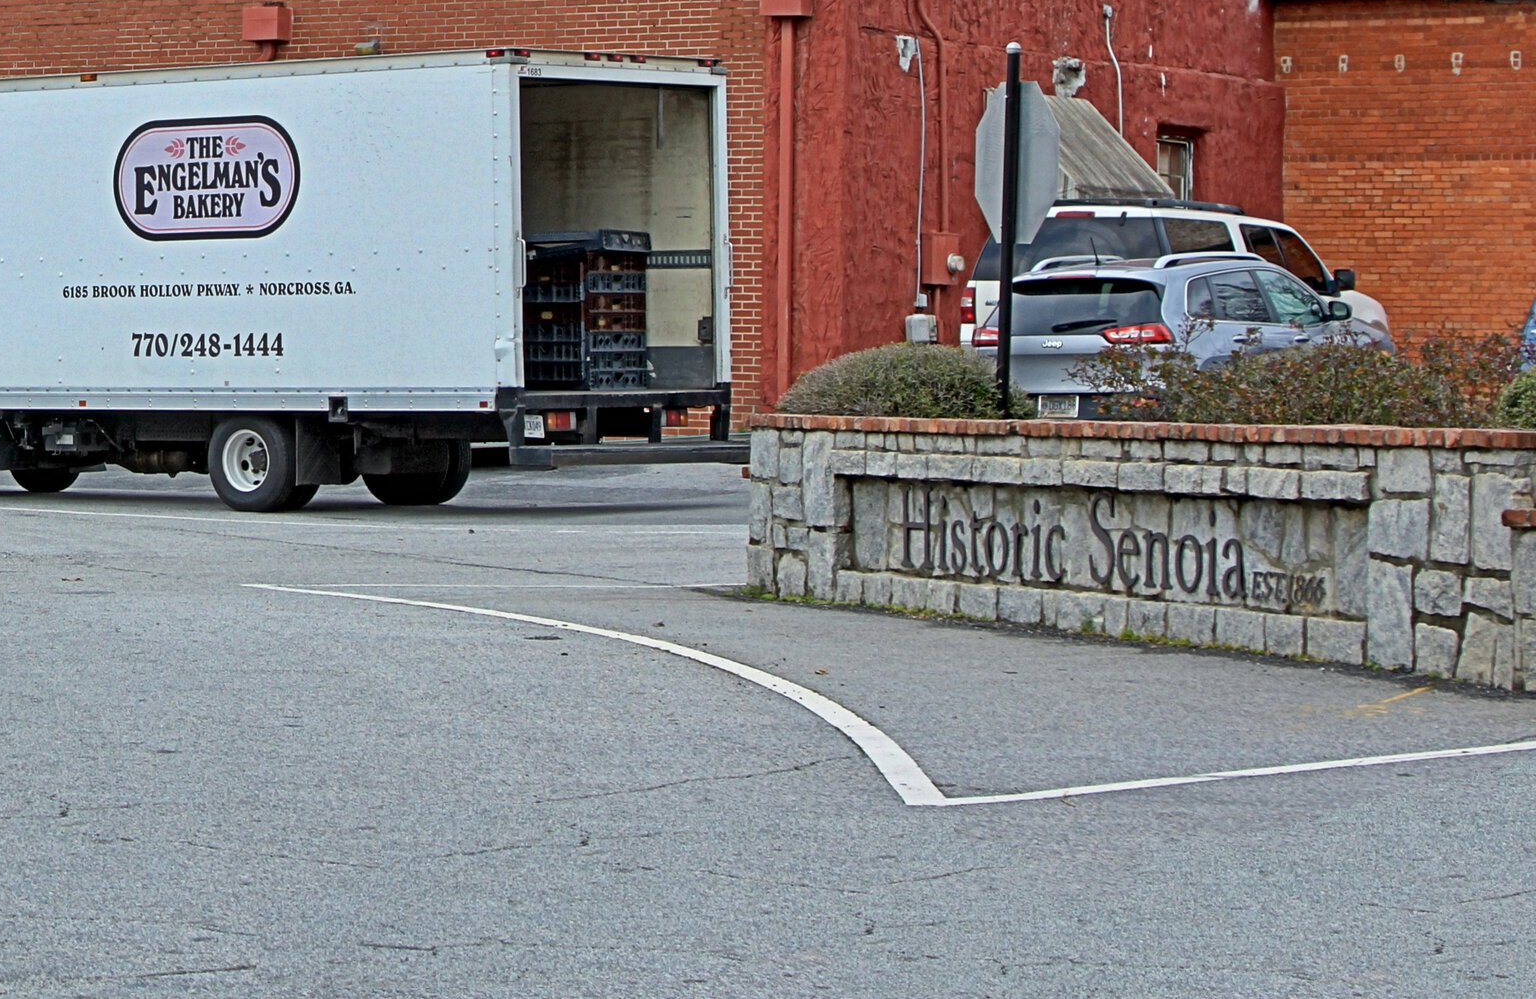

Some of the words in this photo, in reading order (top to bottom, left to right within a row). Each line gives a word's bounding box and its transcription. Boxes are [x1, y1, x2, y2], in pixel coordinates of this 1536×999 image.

[527, 67, 542, 76] 1683
[186, 135, 224, 159] THE
[134, 152, 282, 216] ENGELMAN'S
[173, 193, 245, 219] BAKERY
[62, 285, 89, 299] 6185
[92, 284, 136, 298] BROOK
[140, 283, 193, 298] HOLLOW
[334, 281, 356, 295] GA.
[131, 332, 284, 358] 770/248-1444
[1042, 339, 1063, 349] Jeep
[899, 485, 1066, 582] Historic
[1088, 492, 1246, 600] Senoia
